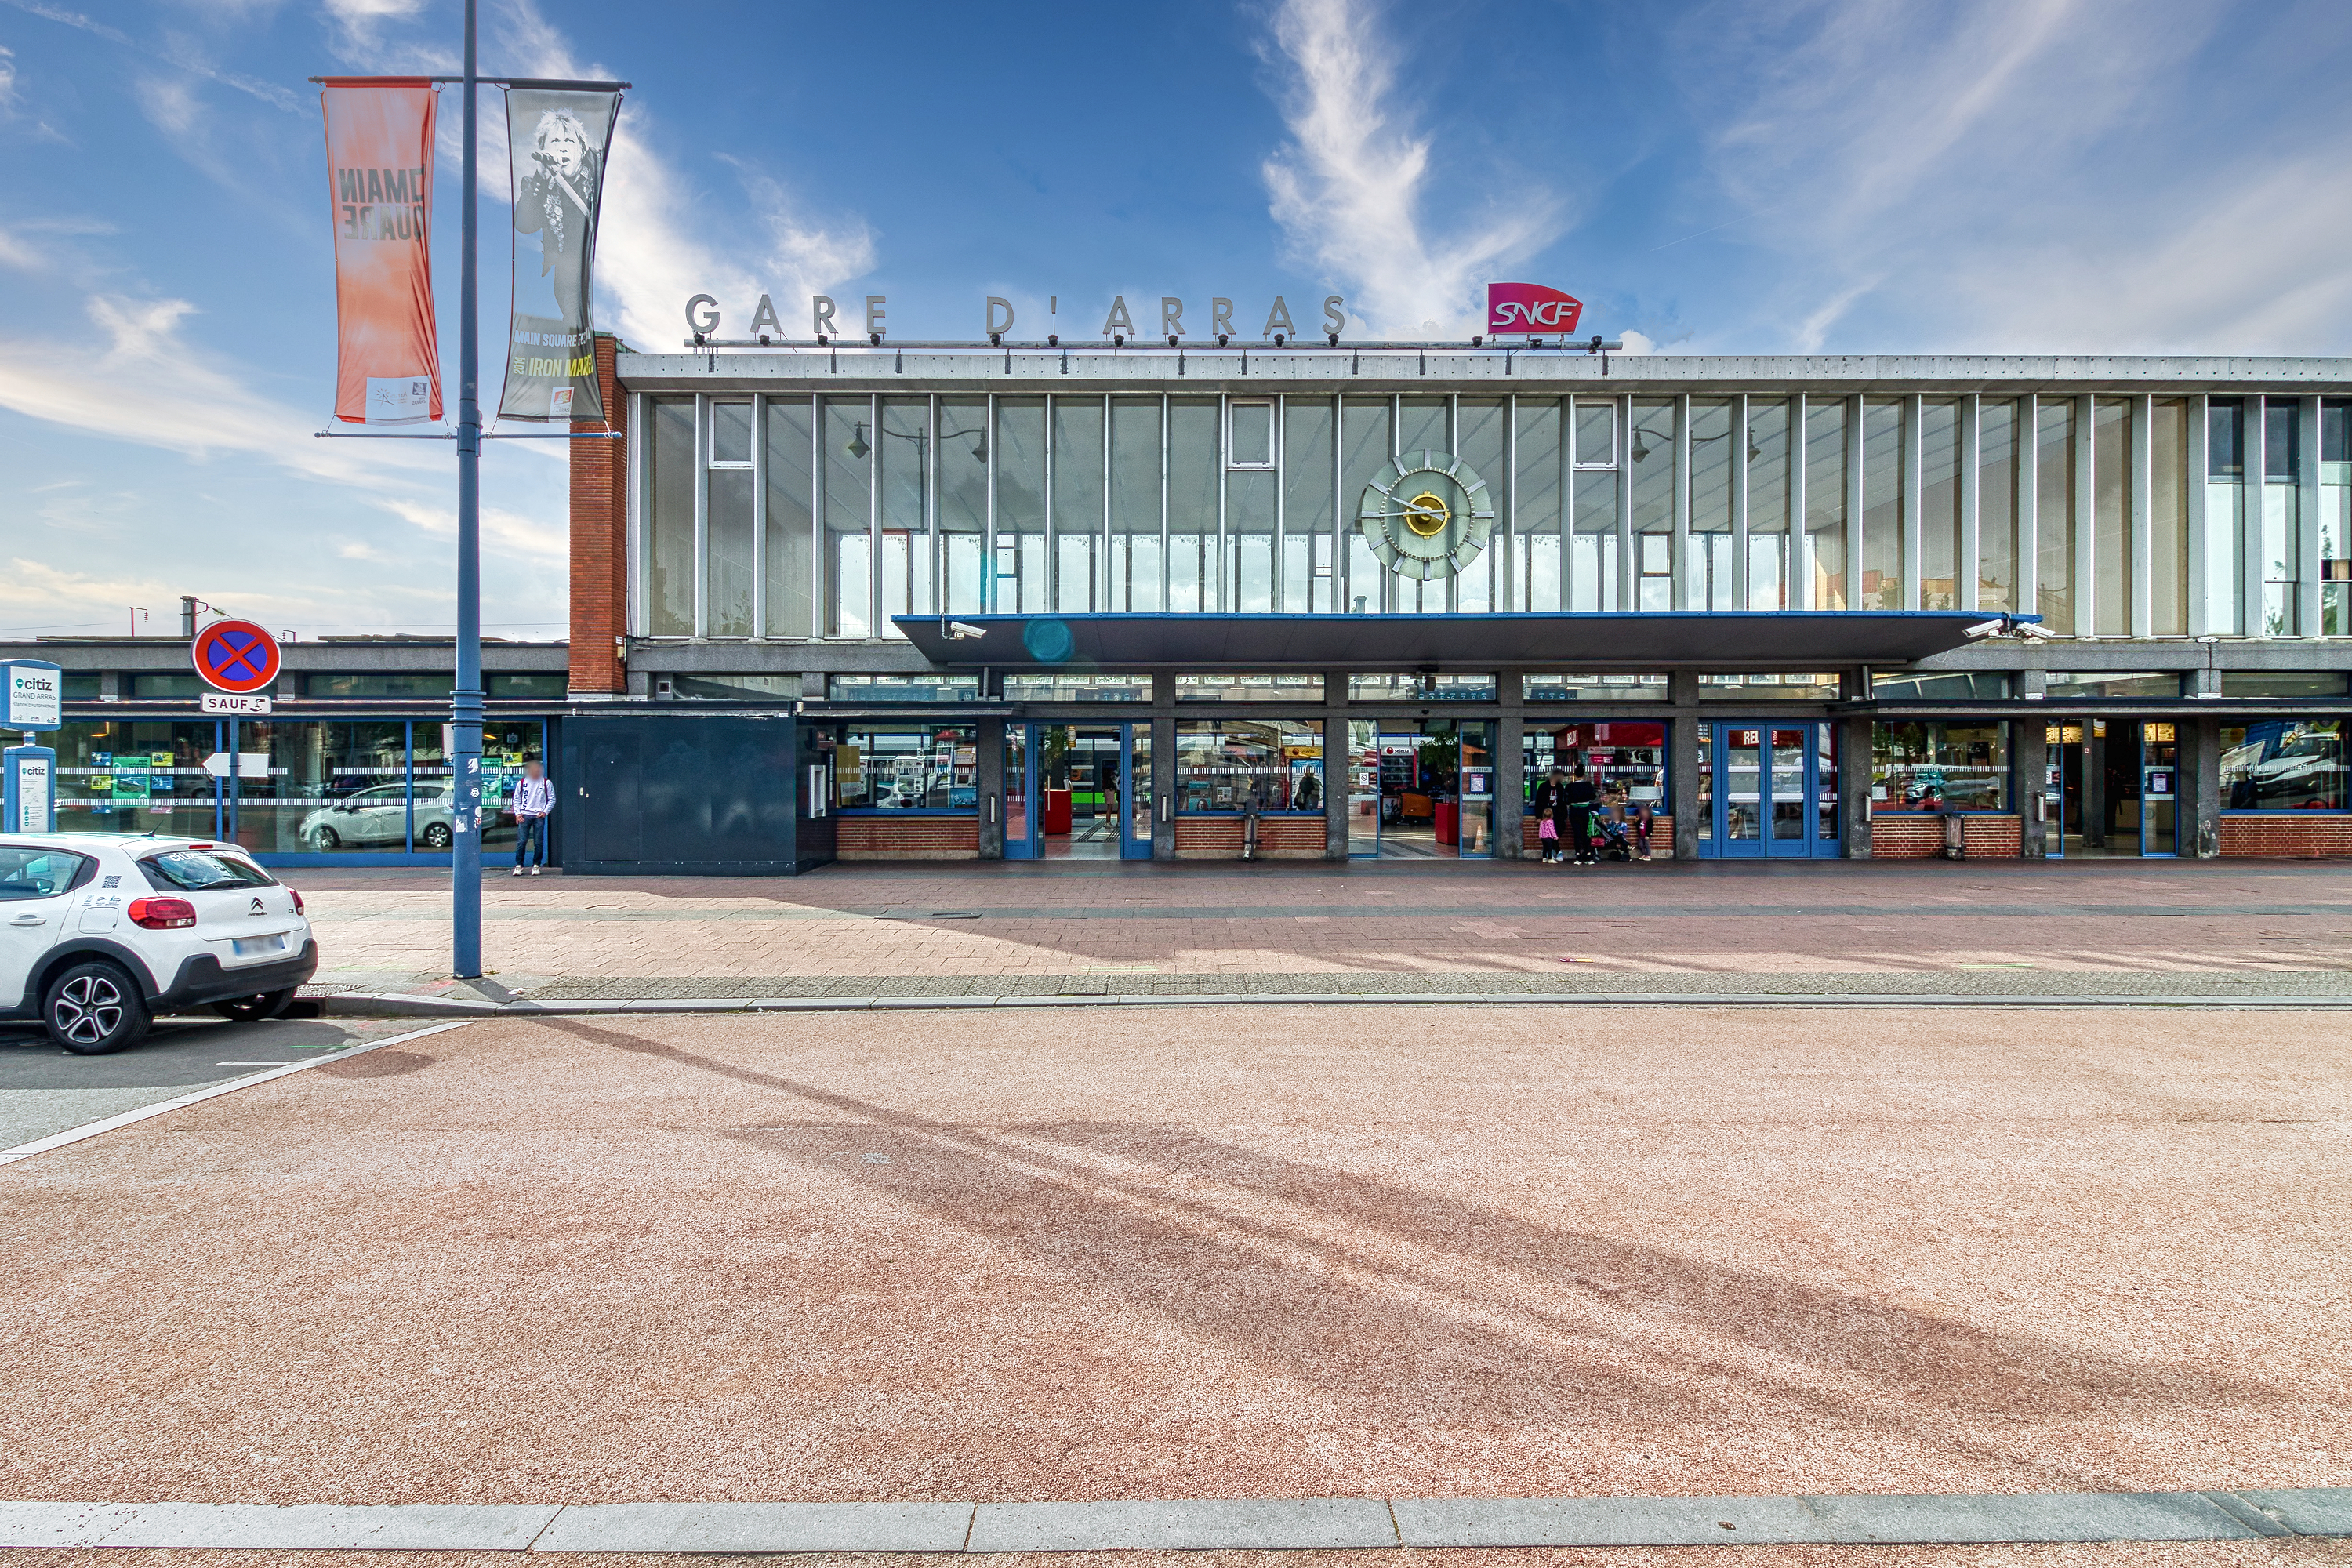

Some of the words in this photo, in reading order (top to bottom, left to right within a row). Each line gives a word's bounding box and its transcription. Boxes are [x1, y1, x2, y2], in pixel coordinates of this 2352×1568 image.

[685, 293, 887, 334] GARE
[986, 295, 1346, 335] D'ARRAS
[1491, 301, 1577, 326] SNCF
[514, 329, 540, 346] MAIN
[542, 333, 577, 347] SQUARE
[513, 356, 525, 375] 2014
[528, 357, 562, 377] IRON
[24, 677, 53, 691] citiz
[208, 698, 248, 710] SAUF
[27, 766, 45, 775] citiz
